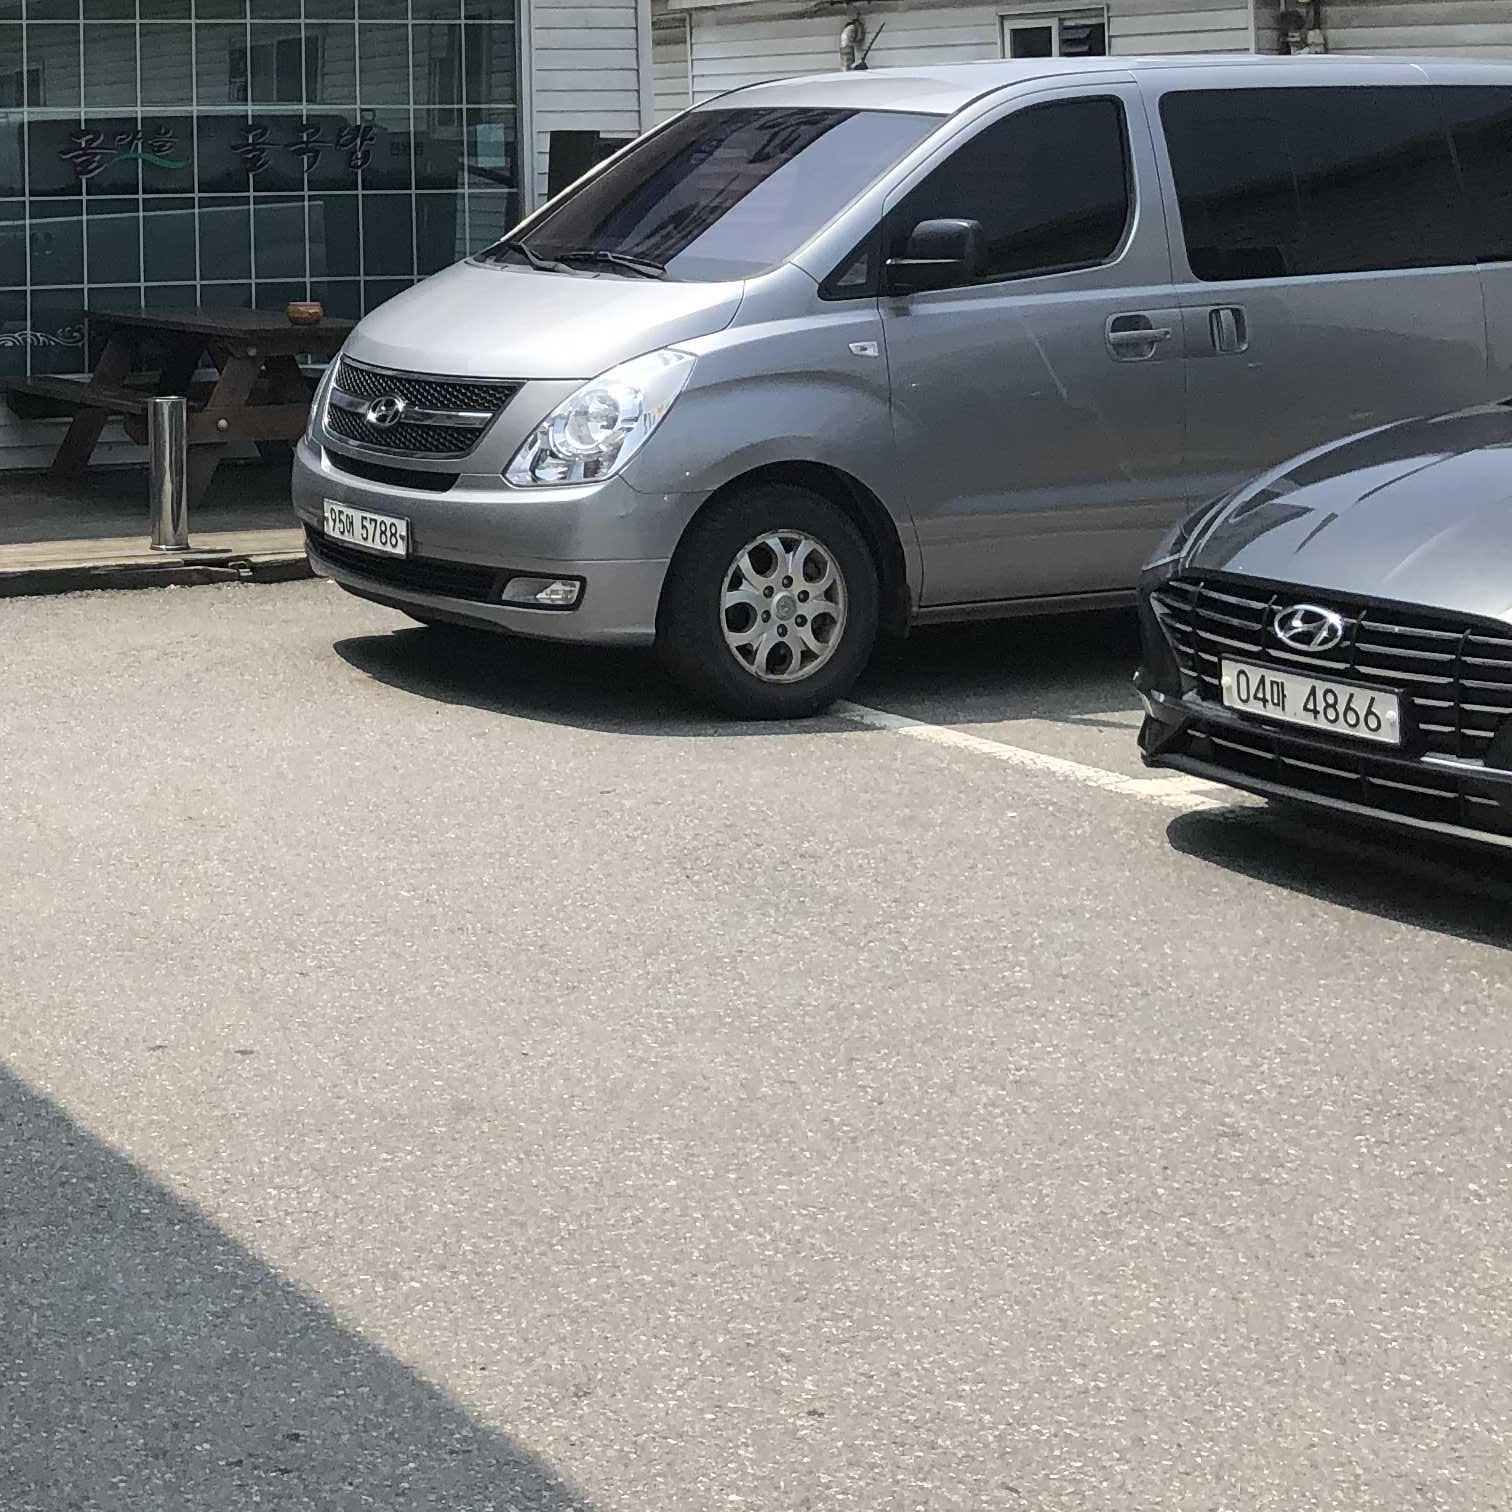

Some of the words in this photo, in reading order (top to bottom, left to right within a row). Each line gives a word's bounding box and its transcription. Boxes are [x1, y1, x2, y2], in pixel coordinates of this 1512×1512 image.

[360, 515, 399, 549] 5788
[1236, 669, 1287, 713] 04마
[1303, 684, 1382, 733] 4866
